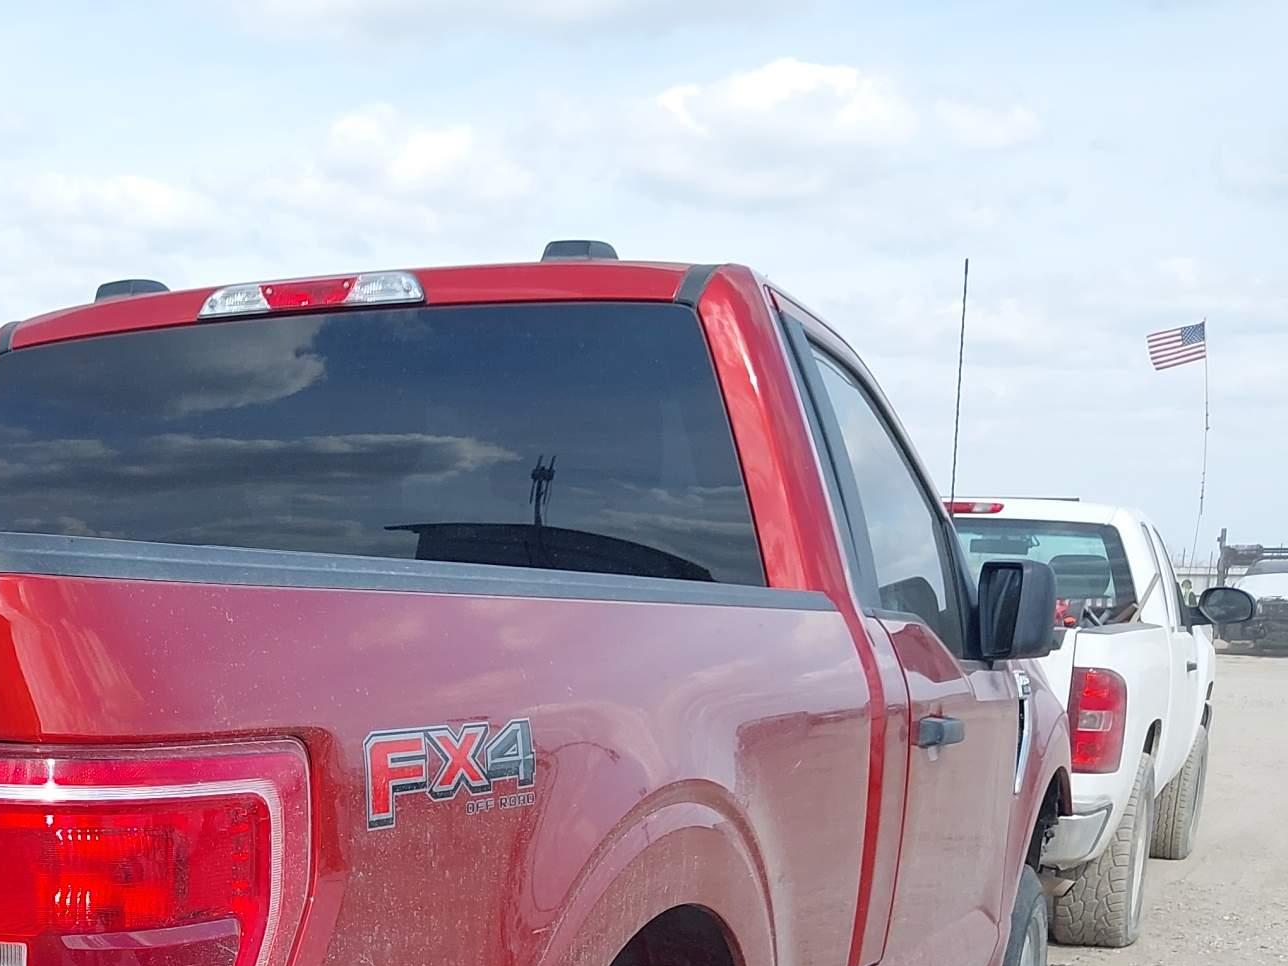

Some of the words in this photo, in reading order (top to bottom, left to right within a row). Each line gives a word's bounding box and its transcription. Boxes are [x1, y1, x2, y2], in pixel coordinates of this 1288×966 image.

[363, 717, 536, 831] FX4
[466, 799, 495, 815] OFF
[499, 791, 535, 809] ROAD
